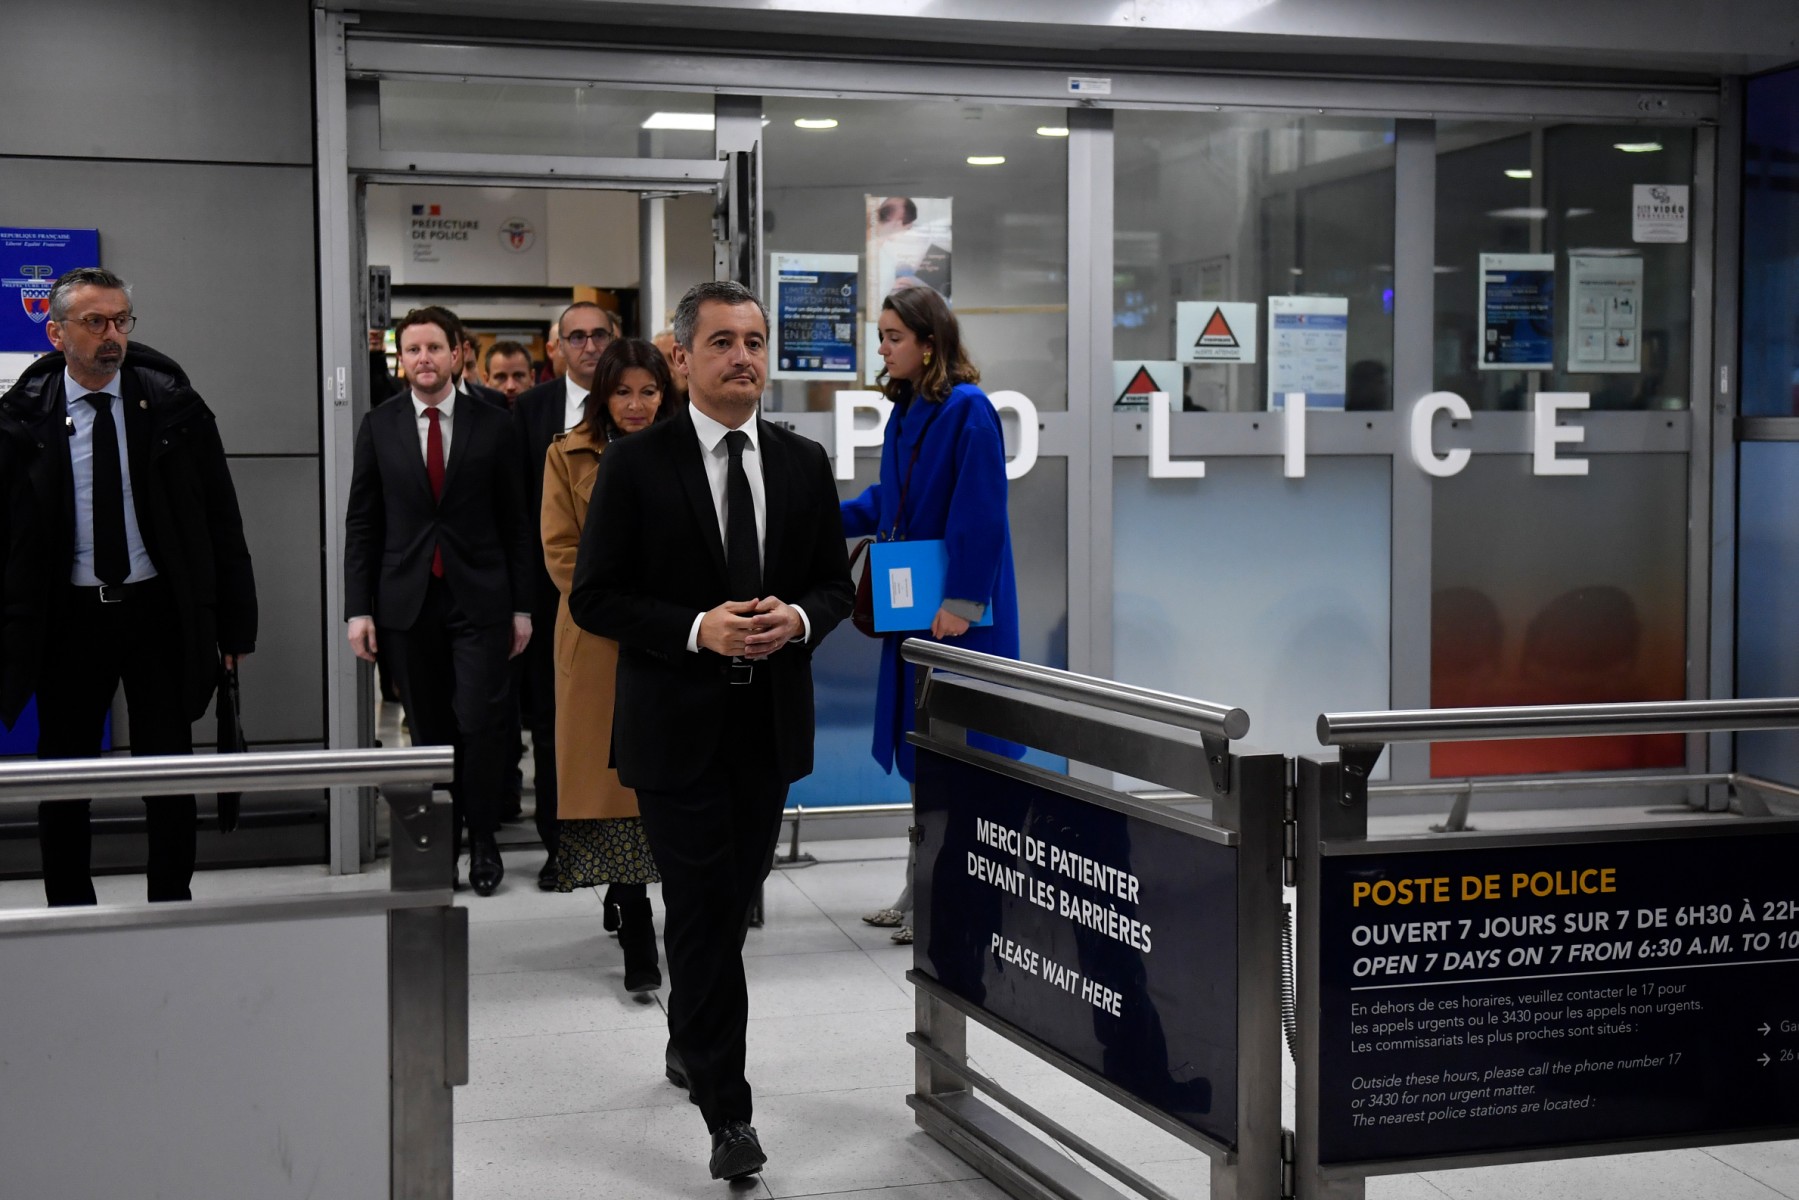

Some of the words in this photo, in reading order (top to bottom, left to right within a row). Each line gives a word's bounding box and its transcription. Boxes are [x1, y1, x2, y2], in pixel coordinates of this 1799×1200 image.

[412, 218, 479, 230] PRÉFECTURE
[412, 230, 425, 239] DE
[430, 231, 468, 240] POLICE
[784, 330, 798, 339] EN
[802, 330, 832, 340] LIGNE
[835, 390, 1590, 480] POLICE
[977, 817, 1020, 857] MERCI
[1025, 836, 1046, 867] DE
[1050, 845, 1139, 905] PATIENTER
[968, 851, 1025, 898] DEVANT
[1029, 877, 1055, 911] LES
[1060, 890, 1152, 953] BARRIÈRES
[1353, 877, 1450, 907] POSTE
[1461, 874, 1501, 900] DE
[1512, 868, 1616, 898] POLICE
[1351, 921, 1451, 946] OUVERT
[1458, 920, 1472, 940] 7
[1478, 914, 1556, 939] JOURS
[1564, 911, 1610, 934] SUR
[1616, 910, 1630, 930] 7
[1637, 908, 1668, 928] DE
[1675, 904, 1732, 926] 6H30
[1739, 898, 1756, 922] À
[1353, 954, 1418, 977] OPEN
[1424, 953, 1438, 972] 7
[1443, 949, 1502, 971] DAYS
[1507, 947, 1544, 967] ON
[1549, 945, 1563, 964] 7
[1568, 941, 1633, 963] FROM
[1638, 938, 1682, 958] 6:30
[1686, 935, 1734, 955] A.M.
[1742, 932, 1770, 951] TO
[991, 932, 1039, 975] PLEASE
[1042, 956, 1079, 994] WAIT
[1081, 977, 1122, 1018] HERE
[1351, 1003, 1367, 1016] En
[1371, 1001, 1415, 1014] dehors
[1418, 998, 1434, 1011] de
[1438, 1000, 1458, 1010] ces
[1462, 995, 1514, 1007] horaires,
[1518, 990, 1563, 1003] veuillez
[1566, 988, 1623, 1000] contacter
[1626, 984, 1637, 996] le
[1641, 983, 1655, 995] 17
[1658, 984, 1686, 997] pour
[1351, 1022, 1368, 1034] les
[1372, 1018, 1414, 1036] appels
[1417, 1016, 1464, 1032] urgents
[1468, 1016, 1483, 1026] ou
[1487, 1012, 1498, 1024] le
[1502, 1010, 1531, 1023] 3430
[1534, 1010, 1563, 1024] pour
[1566, 1007, 1583, 1018] les
[1587, 1003, 1626, 1019] appels
[1630, 1004, 1652, 1014] non
[1656, 1000, 1703, 1015] urgents.
[1352, 1041, 1372, 1053] Les
[1376, 1034, 1463, 1051] commissariats
[1467, 1032, 1484, 1044] les
[1487, 1030, 1513, 1045] plus
[1516, 1026, 1565, 1044] proches
[1568, 1025, 1594, 1037] sont
[1597, 1021, 1632, 1034] situés
[1780, 1049, 1794, 1061] 26
[1352, 1074, 1402, 1090] Outside
[1405, 1072, 1440, 1085] these
[1443, 1070, 1480, 1083] hours,
[1483, 1066, 1525, 1082] please
[1528, 1062, 1549, 1076] call
[1552, 1061, 1571, 1074] the
[1574, 1059, 1614, 1075] phone
[1617, 1054, 1664, 1069] number
[1668, 1052, 1682, 1065] 17
[1351, 1099, 1365, 1108] or
[1368, 1093, 1398, 1107] 3430
[1401, 1091, 1419, 1104] for
[1422, 1091, 1445, 1102] non
[1450, 1087, 1490, 1102] urgent
[1494, 1084, 1536, 1098] matter.
[1352, 1113, 1375, 1126] The
[1378, 1112, 1425, 1125] nearest
[1428, 1106, 1466, 1123] police
[1470, 1103, 1517, 1117] stations
[1521, 1102, 1539, 1113] are
[1543, 1095, 1590, 1111] located
